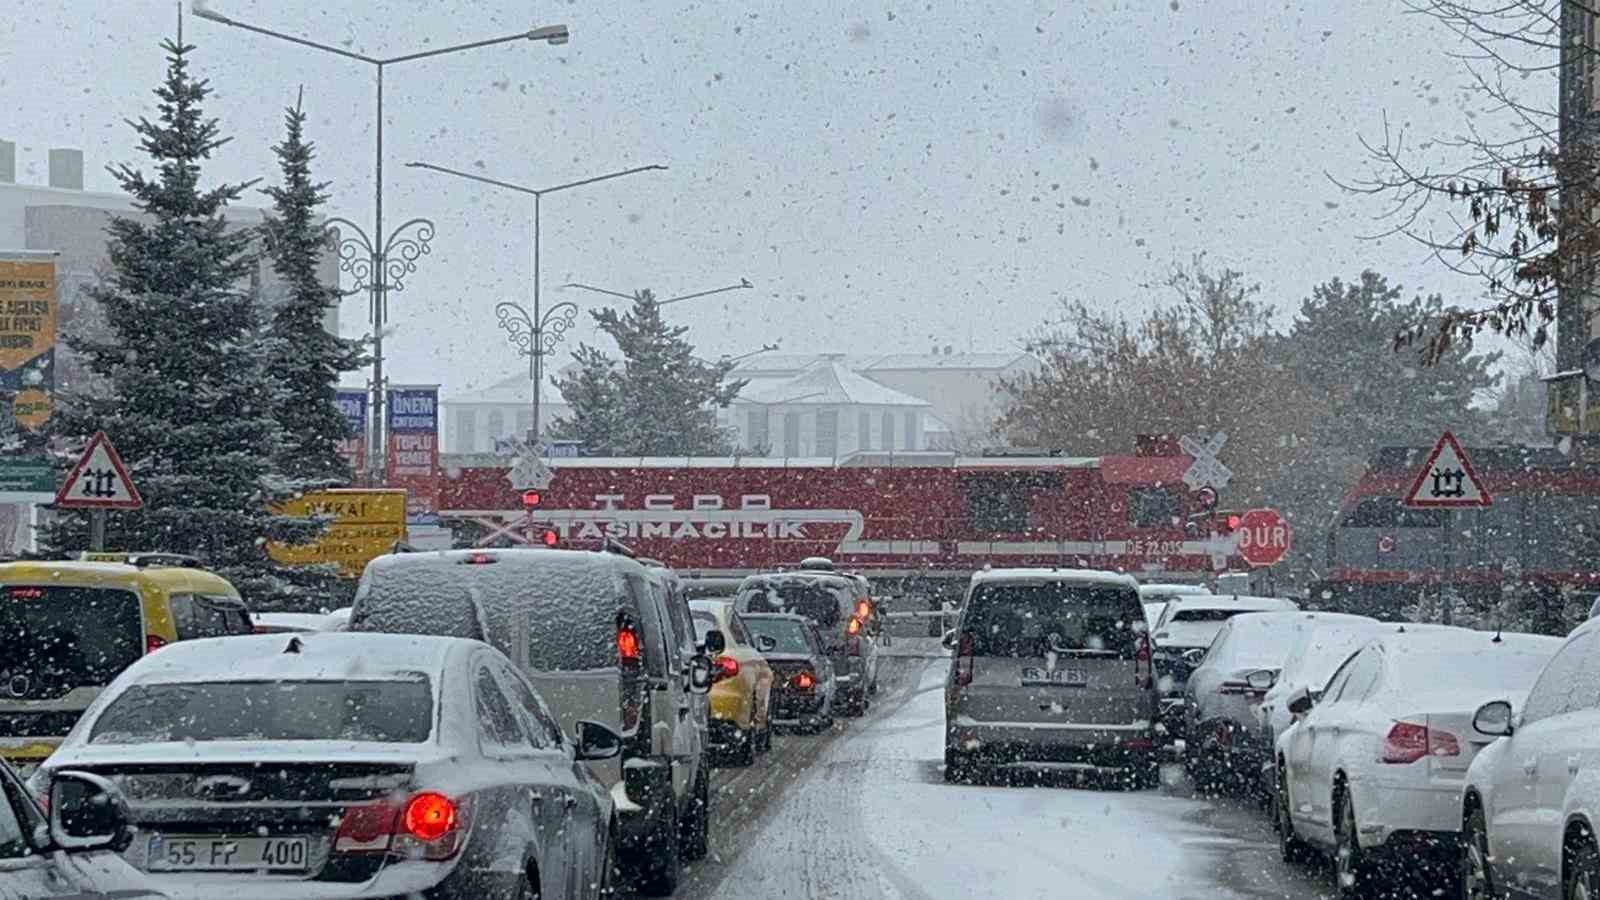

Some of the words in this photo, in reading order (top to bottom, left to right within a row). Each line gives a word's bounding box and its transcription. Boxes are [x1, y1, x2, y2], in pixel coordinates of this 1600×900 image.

[595, 494, 771, 510] TCDD
[1239, 526, 1286, 548] DUR
[167, 841, 196, 865] 55
[261, 841, 303, 865] 400
